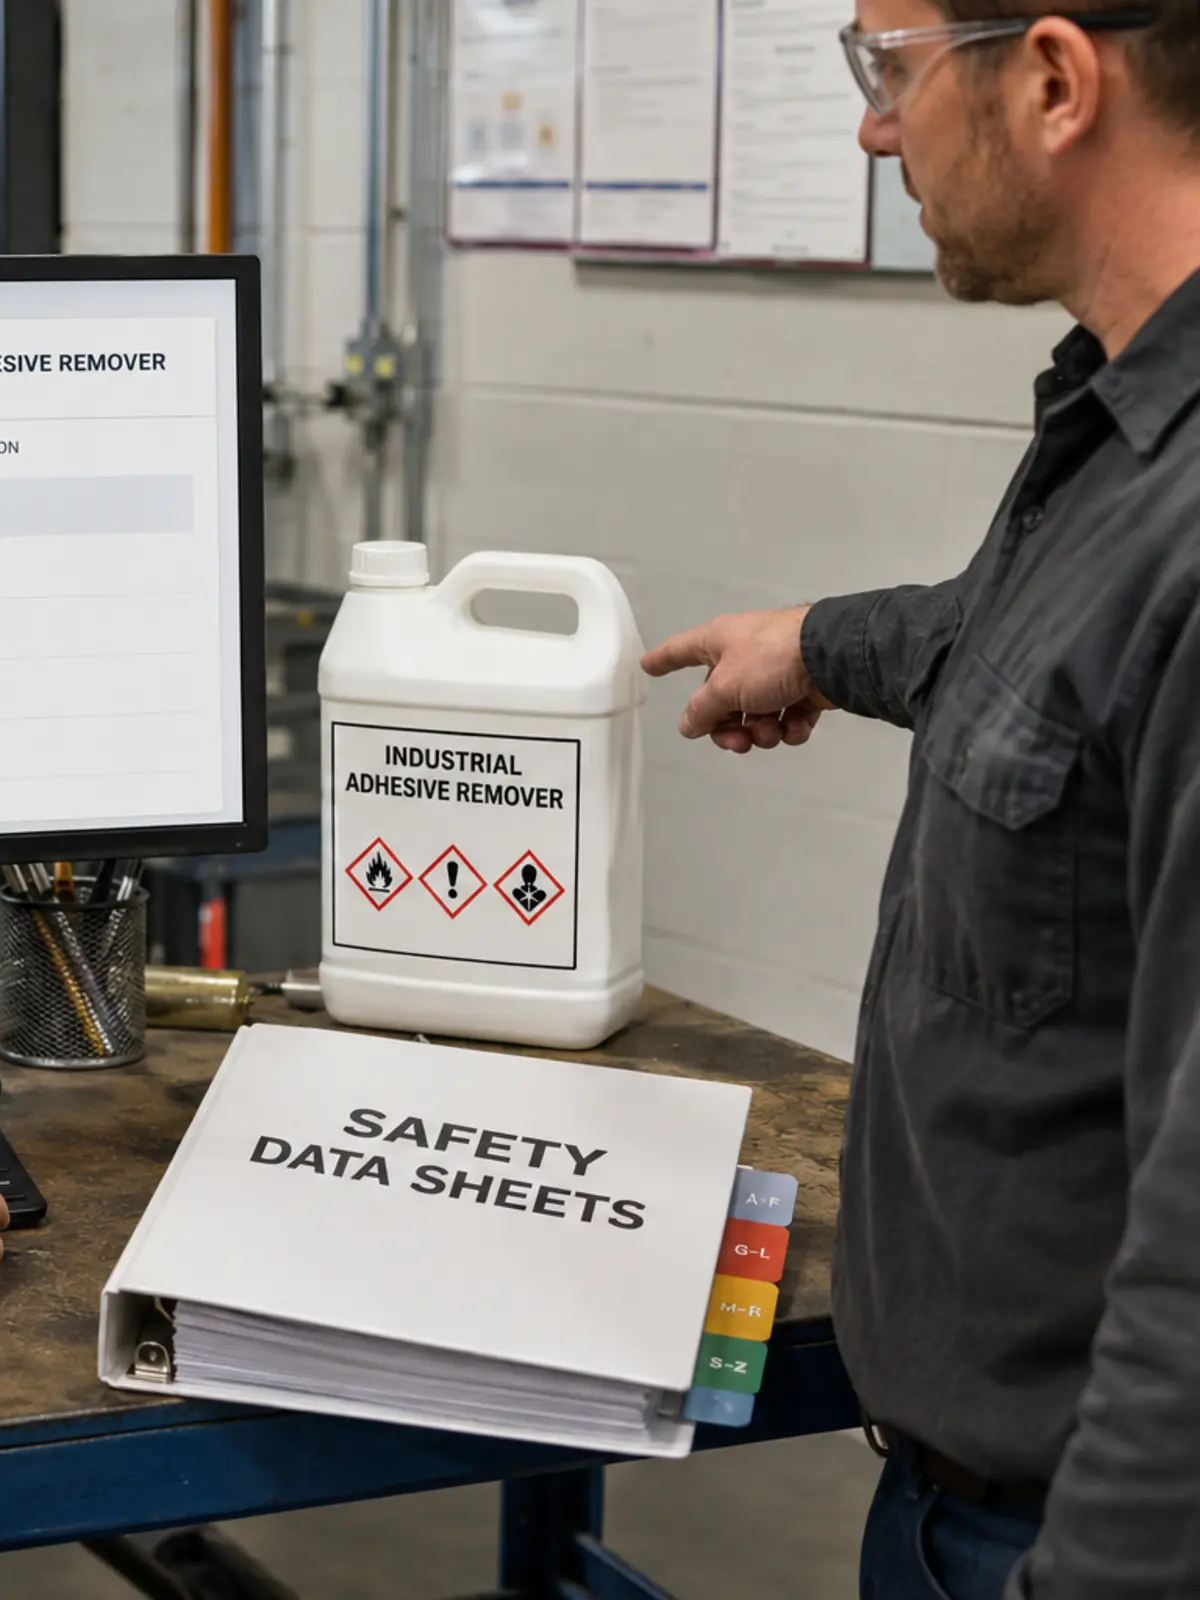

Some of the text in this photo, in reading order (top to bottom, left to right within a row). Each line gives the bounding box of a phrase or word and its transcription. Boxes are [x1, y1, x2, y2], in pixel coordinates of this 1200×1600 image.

[59, 352, 166, 372] REMOVER
[384, 744, 523, 777] INDUSTRIAL
[345, 772, 564, 810] ADHESIVE REMOVER
[342, 1107, 608, 1177] SAFETY
[249, 1134, 647, 1231] DATA SHEETS
